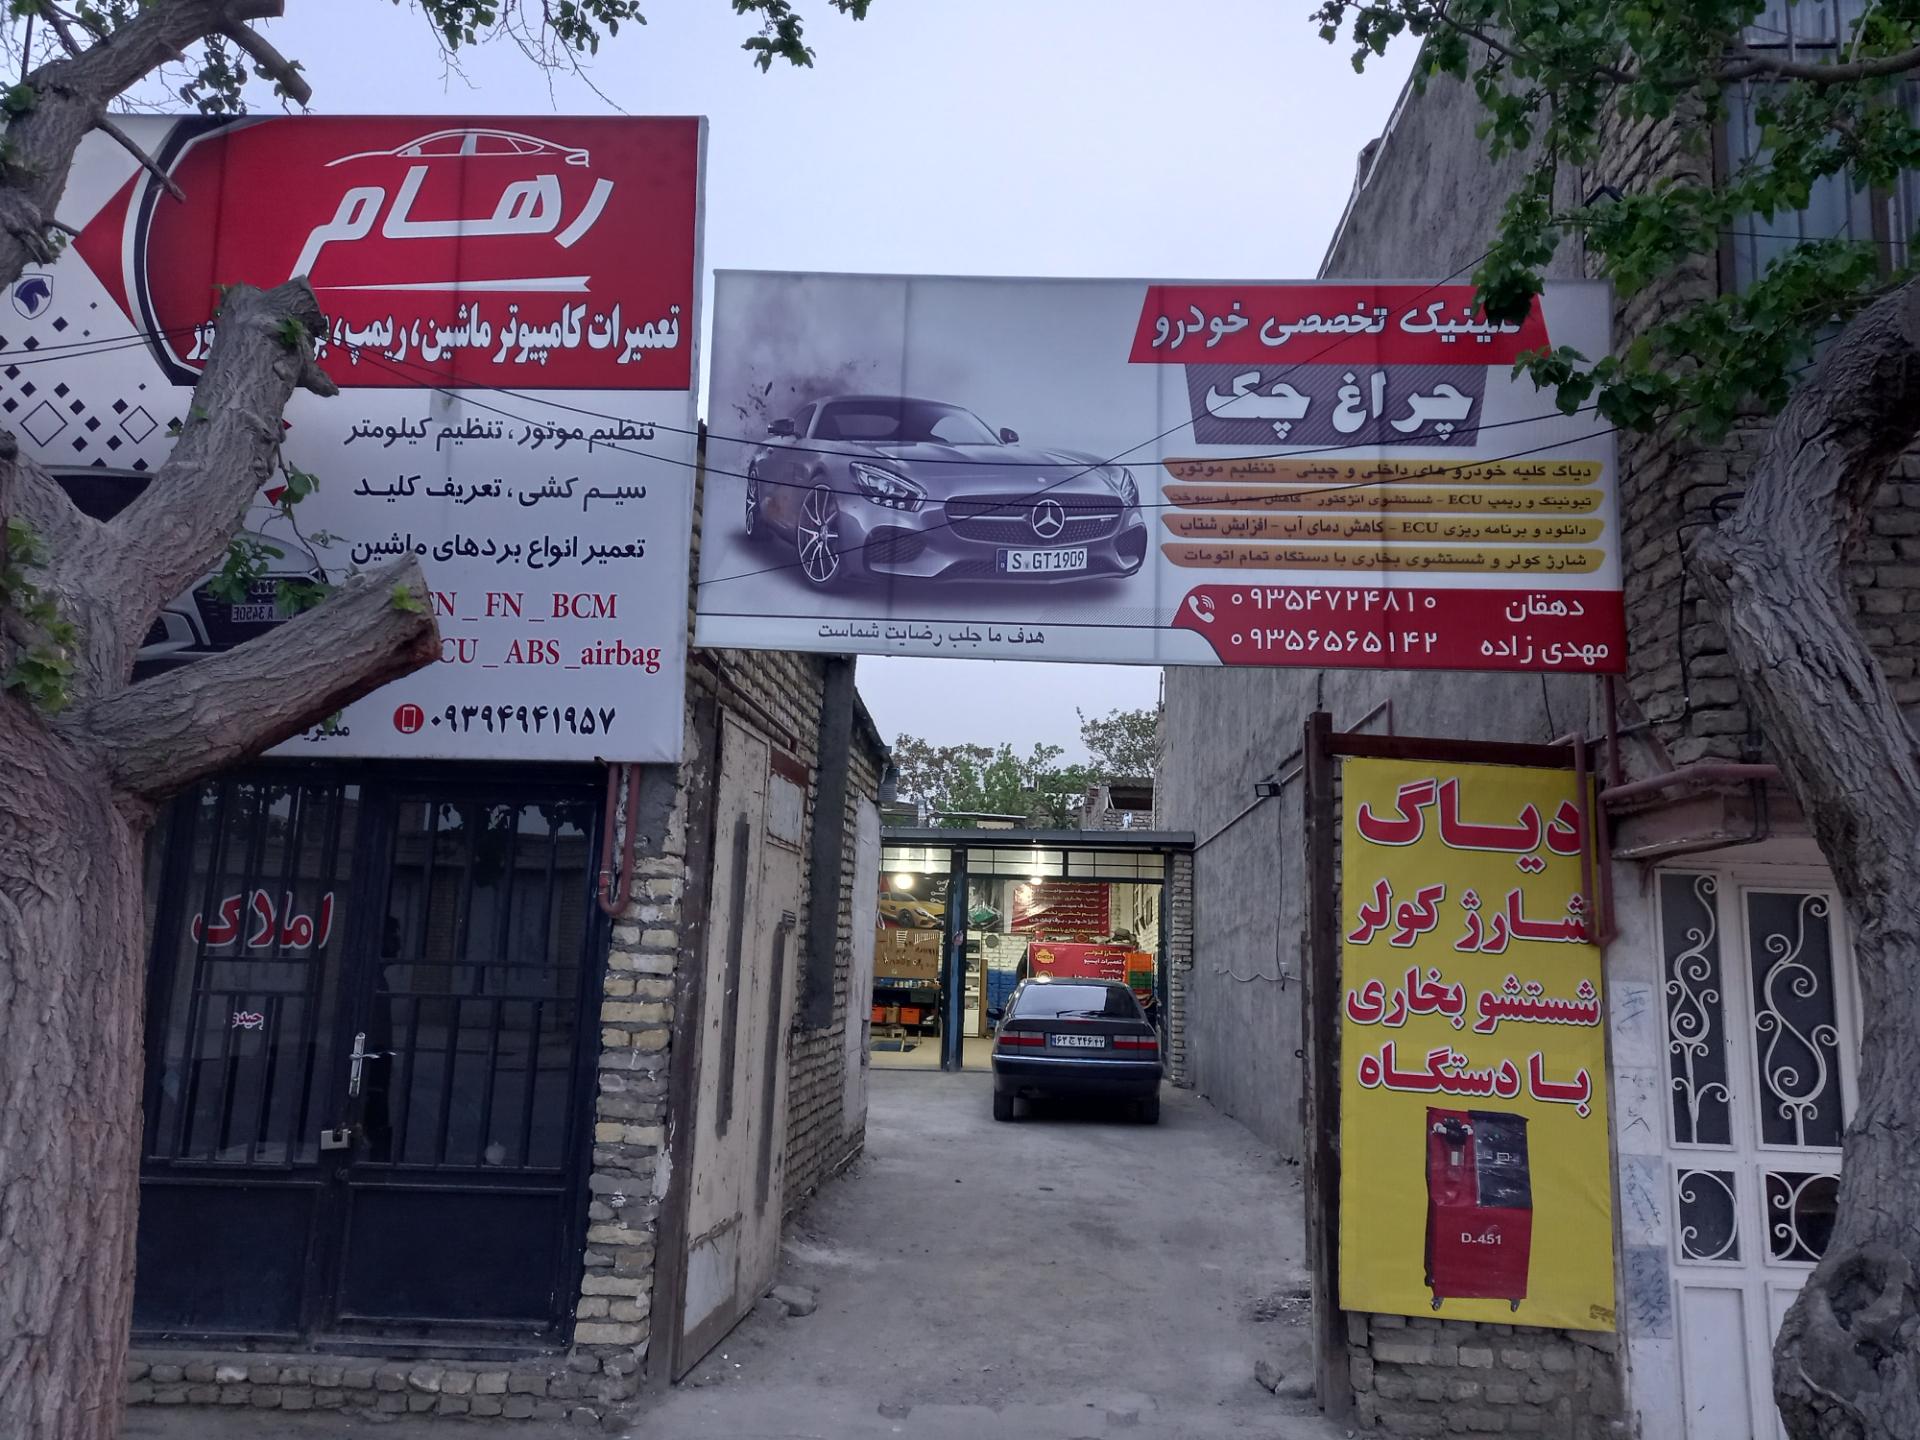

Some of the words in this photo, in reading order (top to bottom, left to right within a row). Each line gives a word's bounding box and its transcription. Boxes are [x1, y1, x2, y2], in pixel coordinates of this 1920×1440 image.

[288, 165, 614, 280] رهام
[492, 303, 586, 365] کامپیوتر
[587, 303, 681, 364] تعمیرات
[1151, 301, 1250, 348] خودرو
[1259, 301, 1387, 345] تخصصی
[1400, 302, 1520, 342] ینیک
[1205, 371, 1311, 439] چک
[1332, 370, 1475, 440] چراغ
[344, 417, 433, 448] کیلومتر
[436, 418, 503, 451] تنظیم
[589, 419, 655, 453] تنظیم
[1230, 463, 1276, 478] تنظیم
[1296, 463, 1339, 479] چینی
[1513, 463, 1546, 481] کلیه
[354, 475, 421, 503] کلید
[426, 478, 502, 505] تعریف
[584, 484, 647, 511] سیم
[1448, 494, 1483, 505] ECU
[1179, 517, 1217, 536] شتاب
[1221, 517, 1268, 536] افزایش
[1284, 515, 1303, 538] آب
[1343, 518, 1385, 536] کاهش
[1403, 522, 1439, 534] ECU
[1545, 524, 1587, 537] دانلود
[351, 533, 428, 565] ماشین
[432, 535, 521, 564] بردهای
[526, 536, 577, 569] انواع
[581, 539, 646, 565] تعمیر
[1032, 551, 1085, 569] GT1909
[1183, 550, 1235, 564] اتومات
[1239, 550, 1269, 566] تمام
[1275, 551, 1329, 562] دستگاه
[1333, 552, 1347, 565] با
[1505, 553, 1541, 569] کولر
[1546, 552, 1587, 569] شارژ
[428, 592, 458, 617] N
[485, 592, 524, 618] FN
[551, 593, 617, 618] BCM
[1506, 593, 1585, 622] دهقان
[817, 622, 880, 641] شماست
[884, 625, 943, 648] رضایت
[948, 626, 982, 648] جلب
[987, 629, 1002, 644] ما
[1006, 629, 1045, 645] هدف
[439, 638, 479, 664] CU
[504, 639, 560, 665] ABS
[1480, 636, 1534, 664] زاده
[1541, 642, 1609, 666] مهدی
[431, 704, 616, 735] ۰۹۳۹۴۹۴۱۹۵۷
[1355, 776, 1582, 874] دیاگ
[191, 889, 335, 950] املاک
[1346, 878, 1445, 949] کولر
[1455, 888, 1594, 953] شارژ
[1346, 964, 1468, 1031] بخاری
[1473, 974, 1603, 1034] شستشو
[1357, 1040, 1520, 1099] دستگاه
[1527, 1050, 1594, 1119] با
